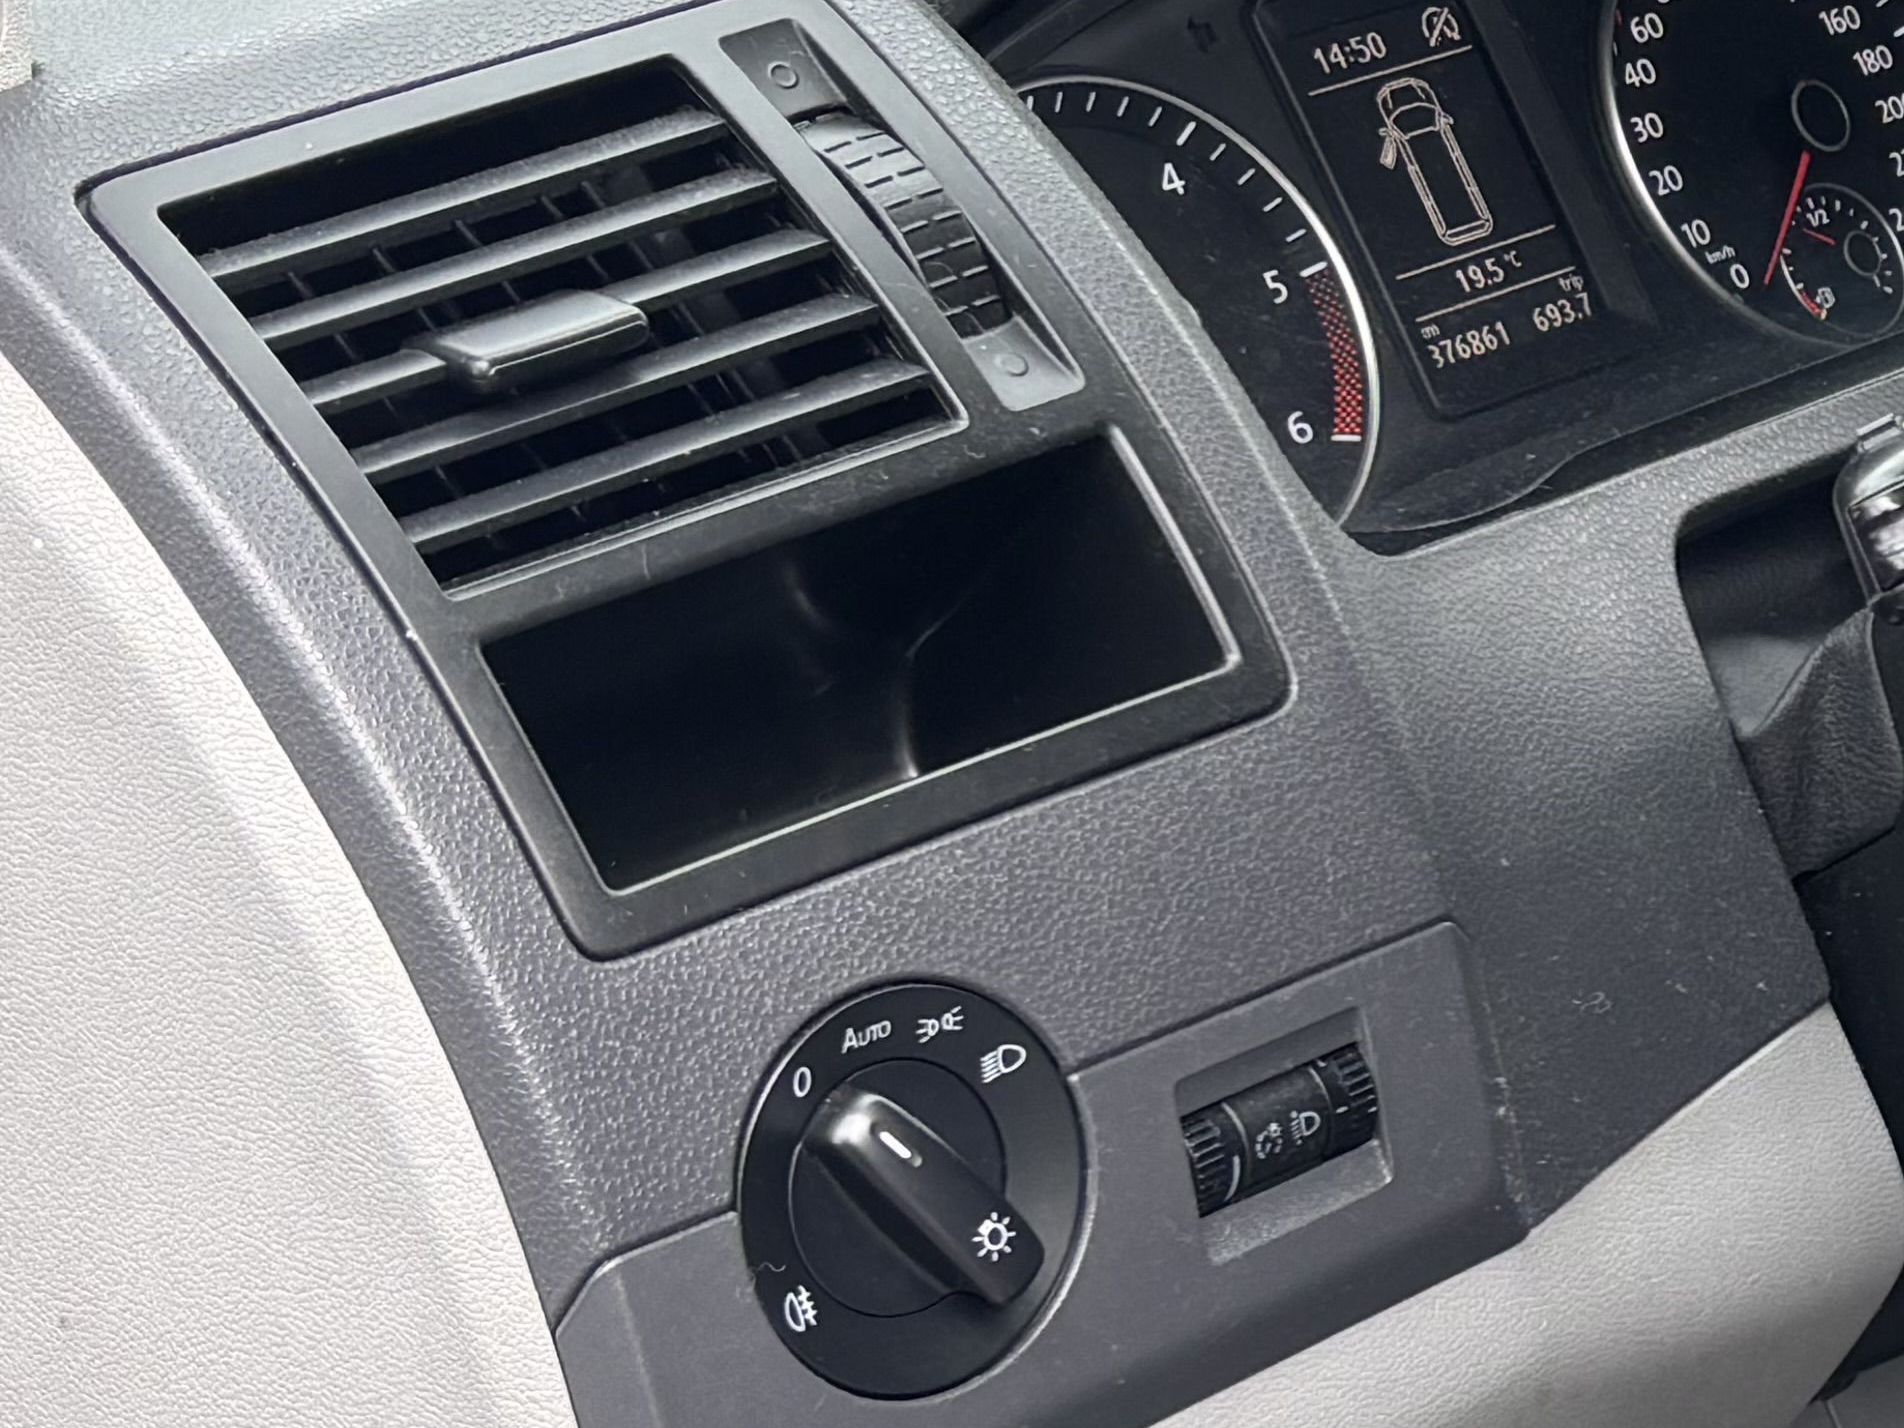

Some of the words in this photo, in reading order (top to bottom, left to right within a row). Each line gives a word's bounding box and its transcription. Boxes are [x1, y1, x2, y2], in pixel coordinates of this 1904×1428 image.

[1630, 12, 1664, 44] 60
[1818, 4, 1861, 36] 160
[1312, 31, 1388, 75] 14:50
[1852, 44, 1893, 76] 180
[1624, 58, 1657, 88] 40
[1630, 112, 1664, 143] 30
[1161, 162, 1186, 195] 4
[1648, 165, 1683, 196] 20
[1681, 218, 1711, 249] 10
[1704, 245, 1737, 265] km/h
[1262, 269, 1288, 304] 5
[1455, 256, 1504, 293] 19.5
[1557, 273, 1585, 293] trip
[1729, 263, 1750, 289] 0
[1532, 291, 1592, 332] 693.7
[1427, 321, 1510, 369] 376861
[1287, 410, 1314, 444] 6
[792, 1066, 812, 1098] 0
